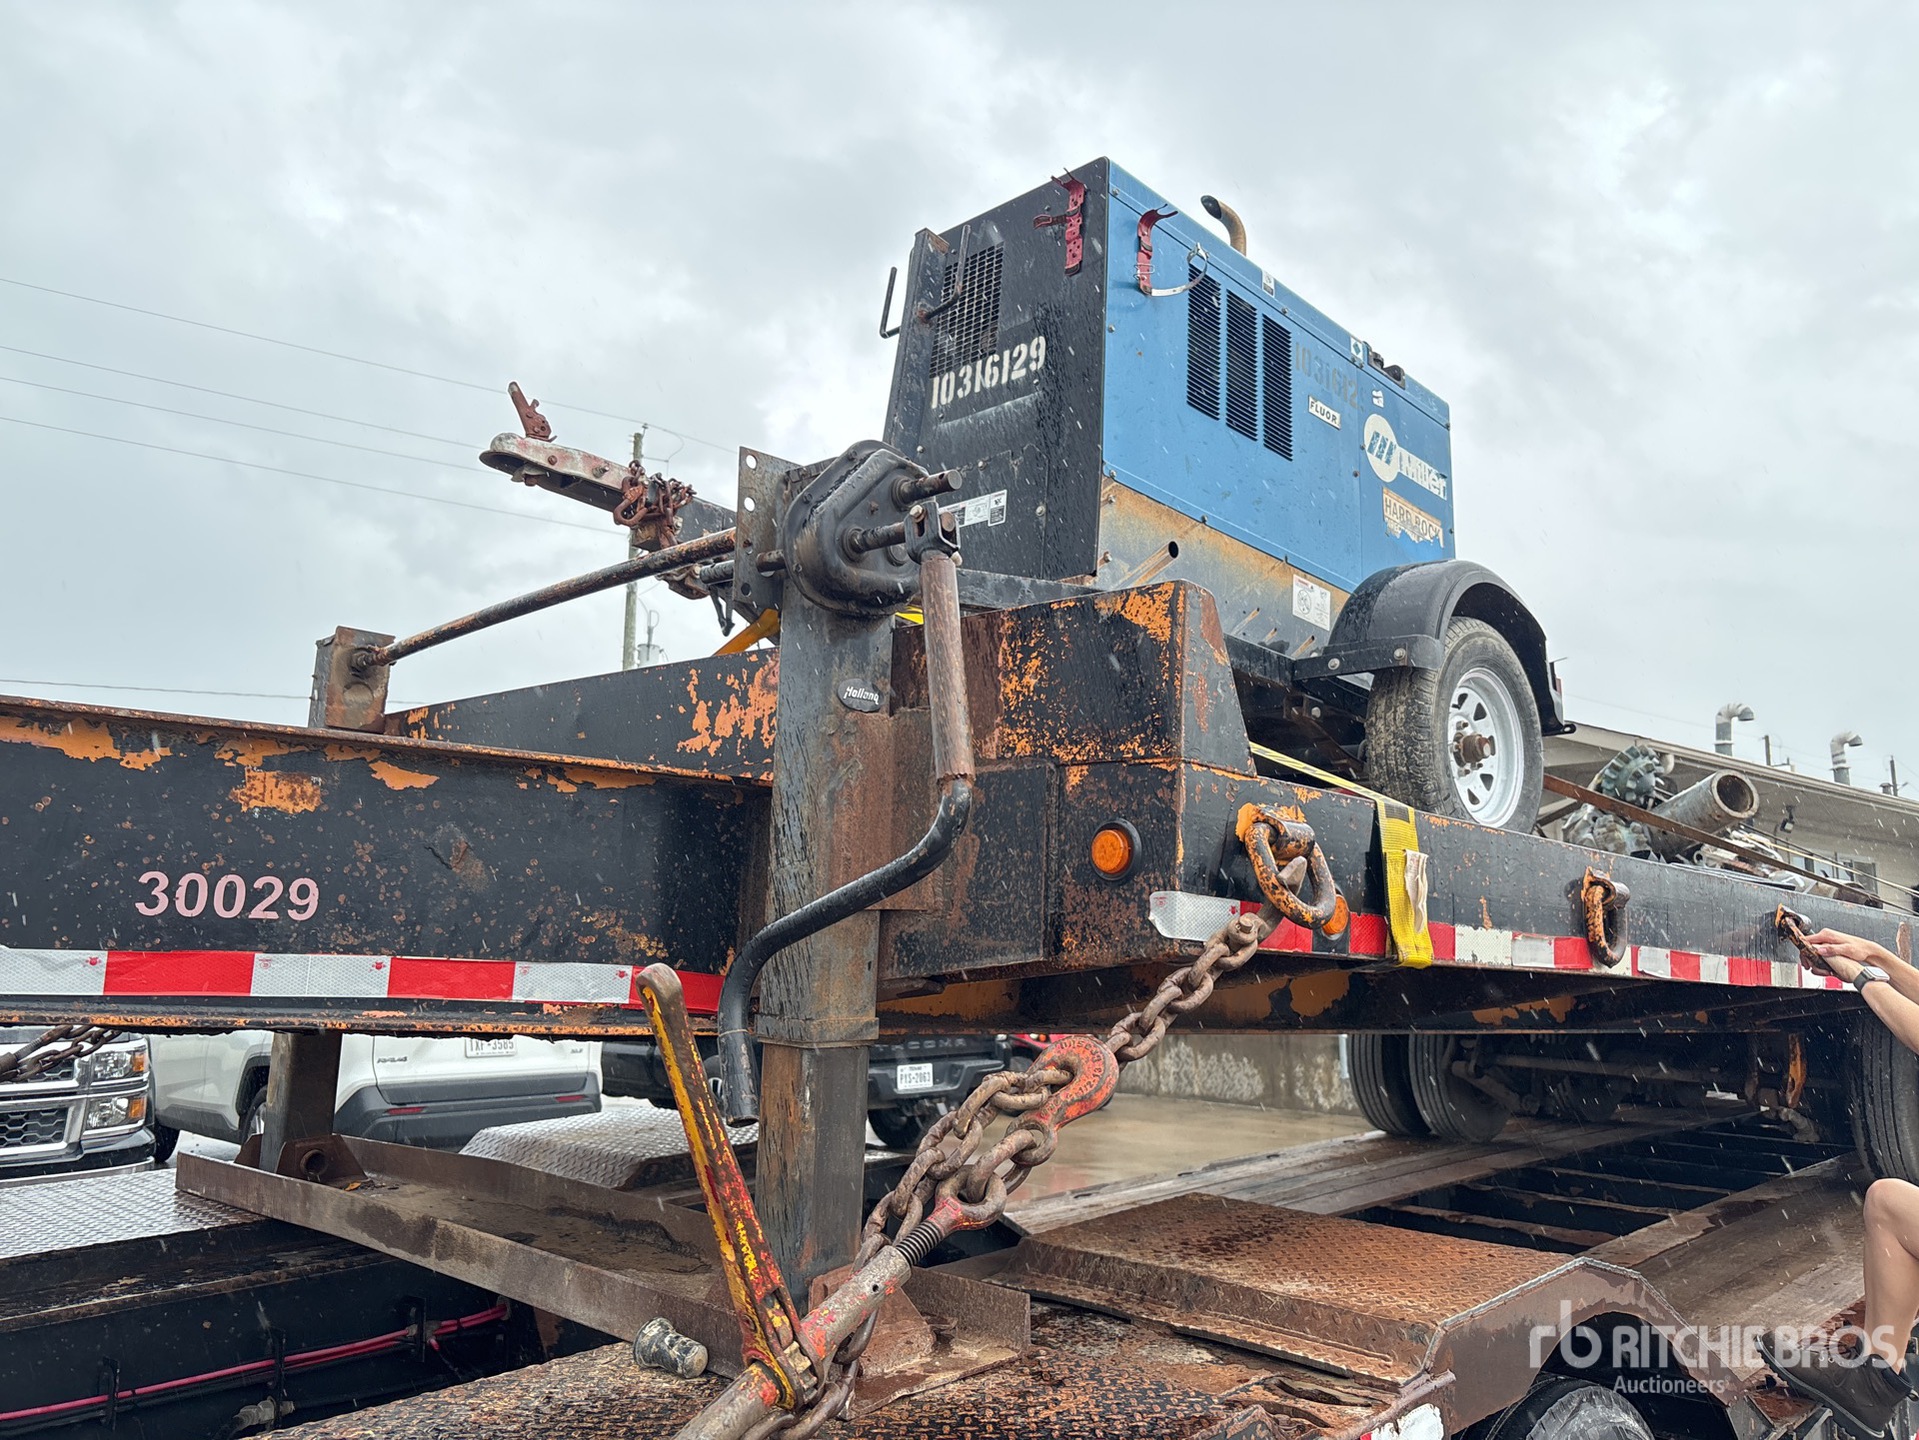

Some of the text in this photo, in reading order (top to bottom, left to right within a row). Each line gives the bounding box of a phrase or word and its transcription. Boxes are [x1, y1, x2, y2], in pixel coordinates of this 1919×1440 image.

[932, 336, 1047, 409] 10316129
[1295, 342, 1365, 412] 1031612
[1309, 400, 1338, 424] FLUOR
[1384, 496, 1412, 524] HARD
[135, 870, 320, 922] 30029
[874, 1038, 967, 1052] TACOMA
